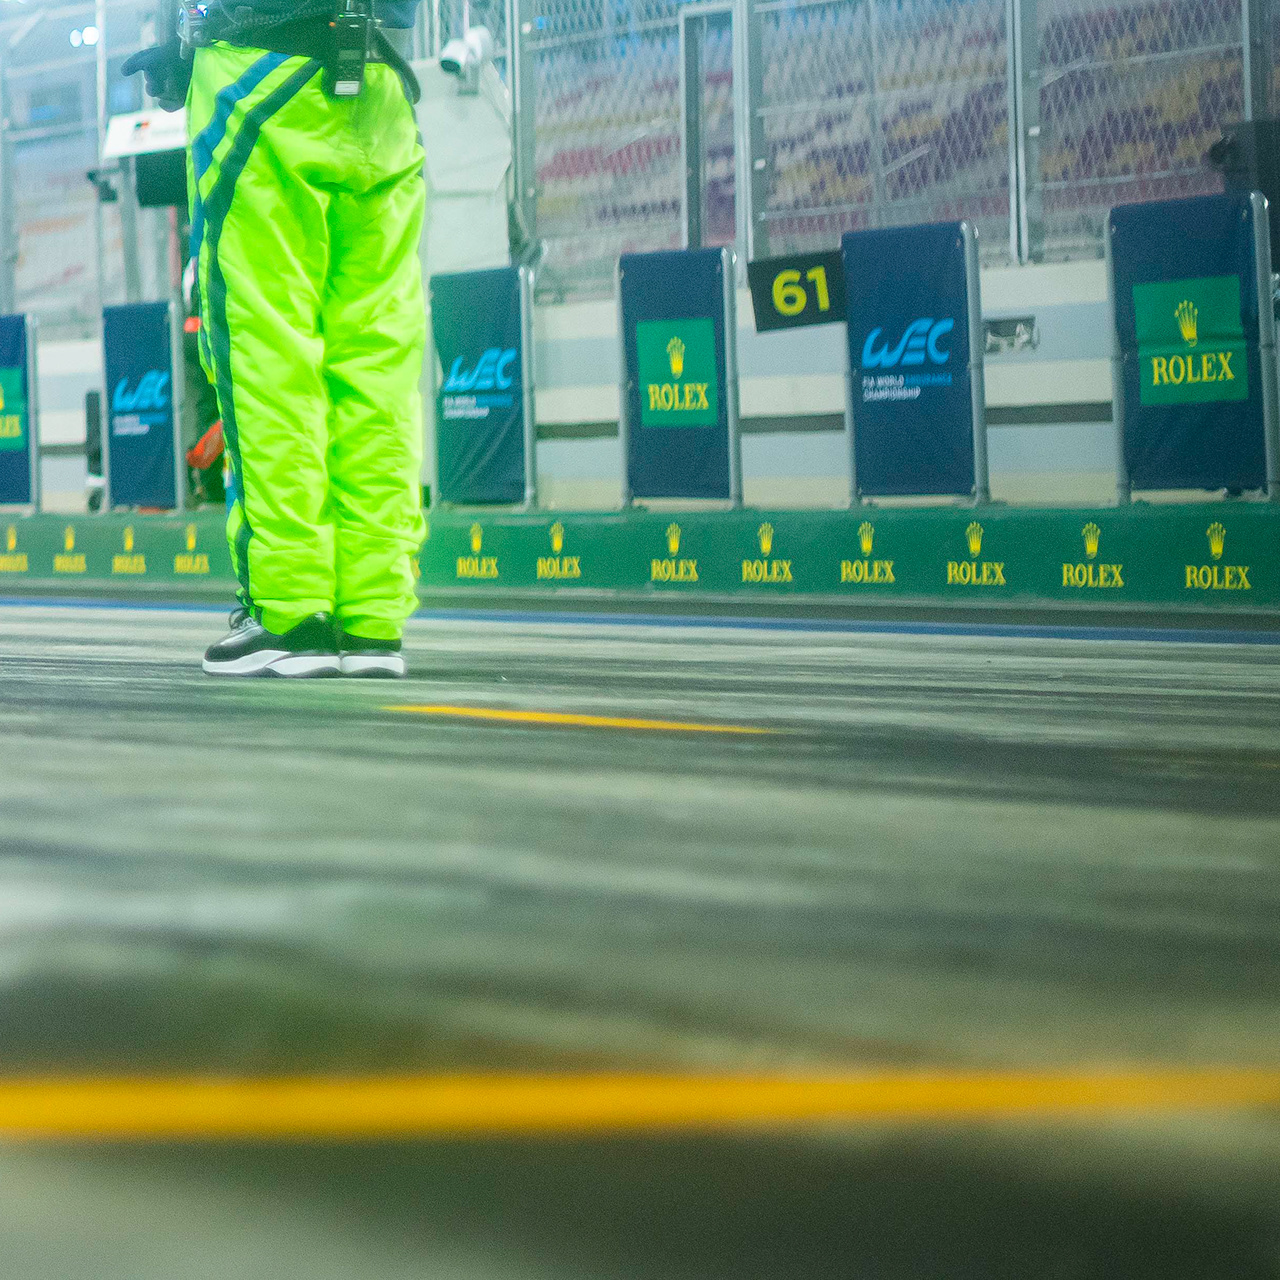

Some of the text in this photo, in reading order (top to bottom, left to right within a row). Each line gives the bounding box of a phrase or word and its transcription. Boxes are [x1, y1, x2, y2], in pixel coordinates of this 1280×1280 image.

[772, 265, 830, 316] 61
[861, 317, 954, 369] WEC
[444, 347, 517, 391] WEC
[1152, 351, 1235, 385] ROLEX
[648, 383, 709, 411] ROLEX
[457, 556, 499, 578] ROLEX
[537, 556, 581, 579] ROLEX
[650, 559, 698, 582] ROLEX
[741, 559, 792, 583] ROLEX
[840, 559, 895, 583] ROLEX
[947, 561, 1006, 586] ROLEX
[1062, 563, 1124, 588] ROLEX
[1184, 565, 1251, 590] ROLEX
